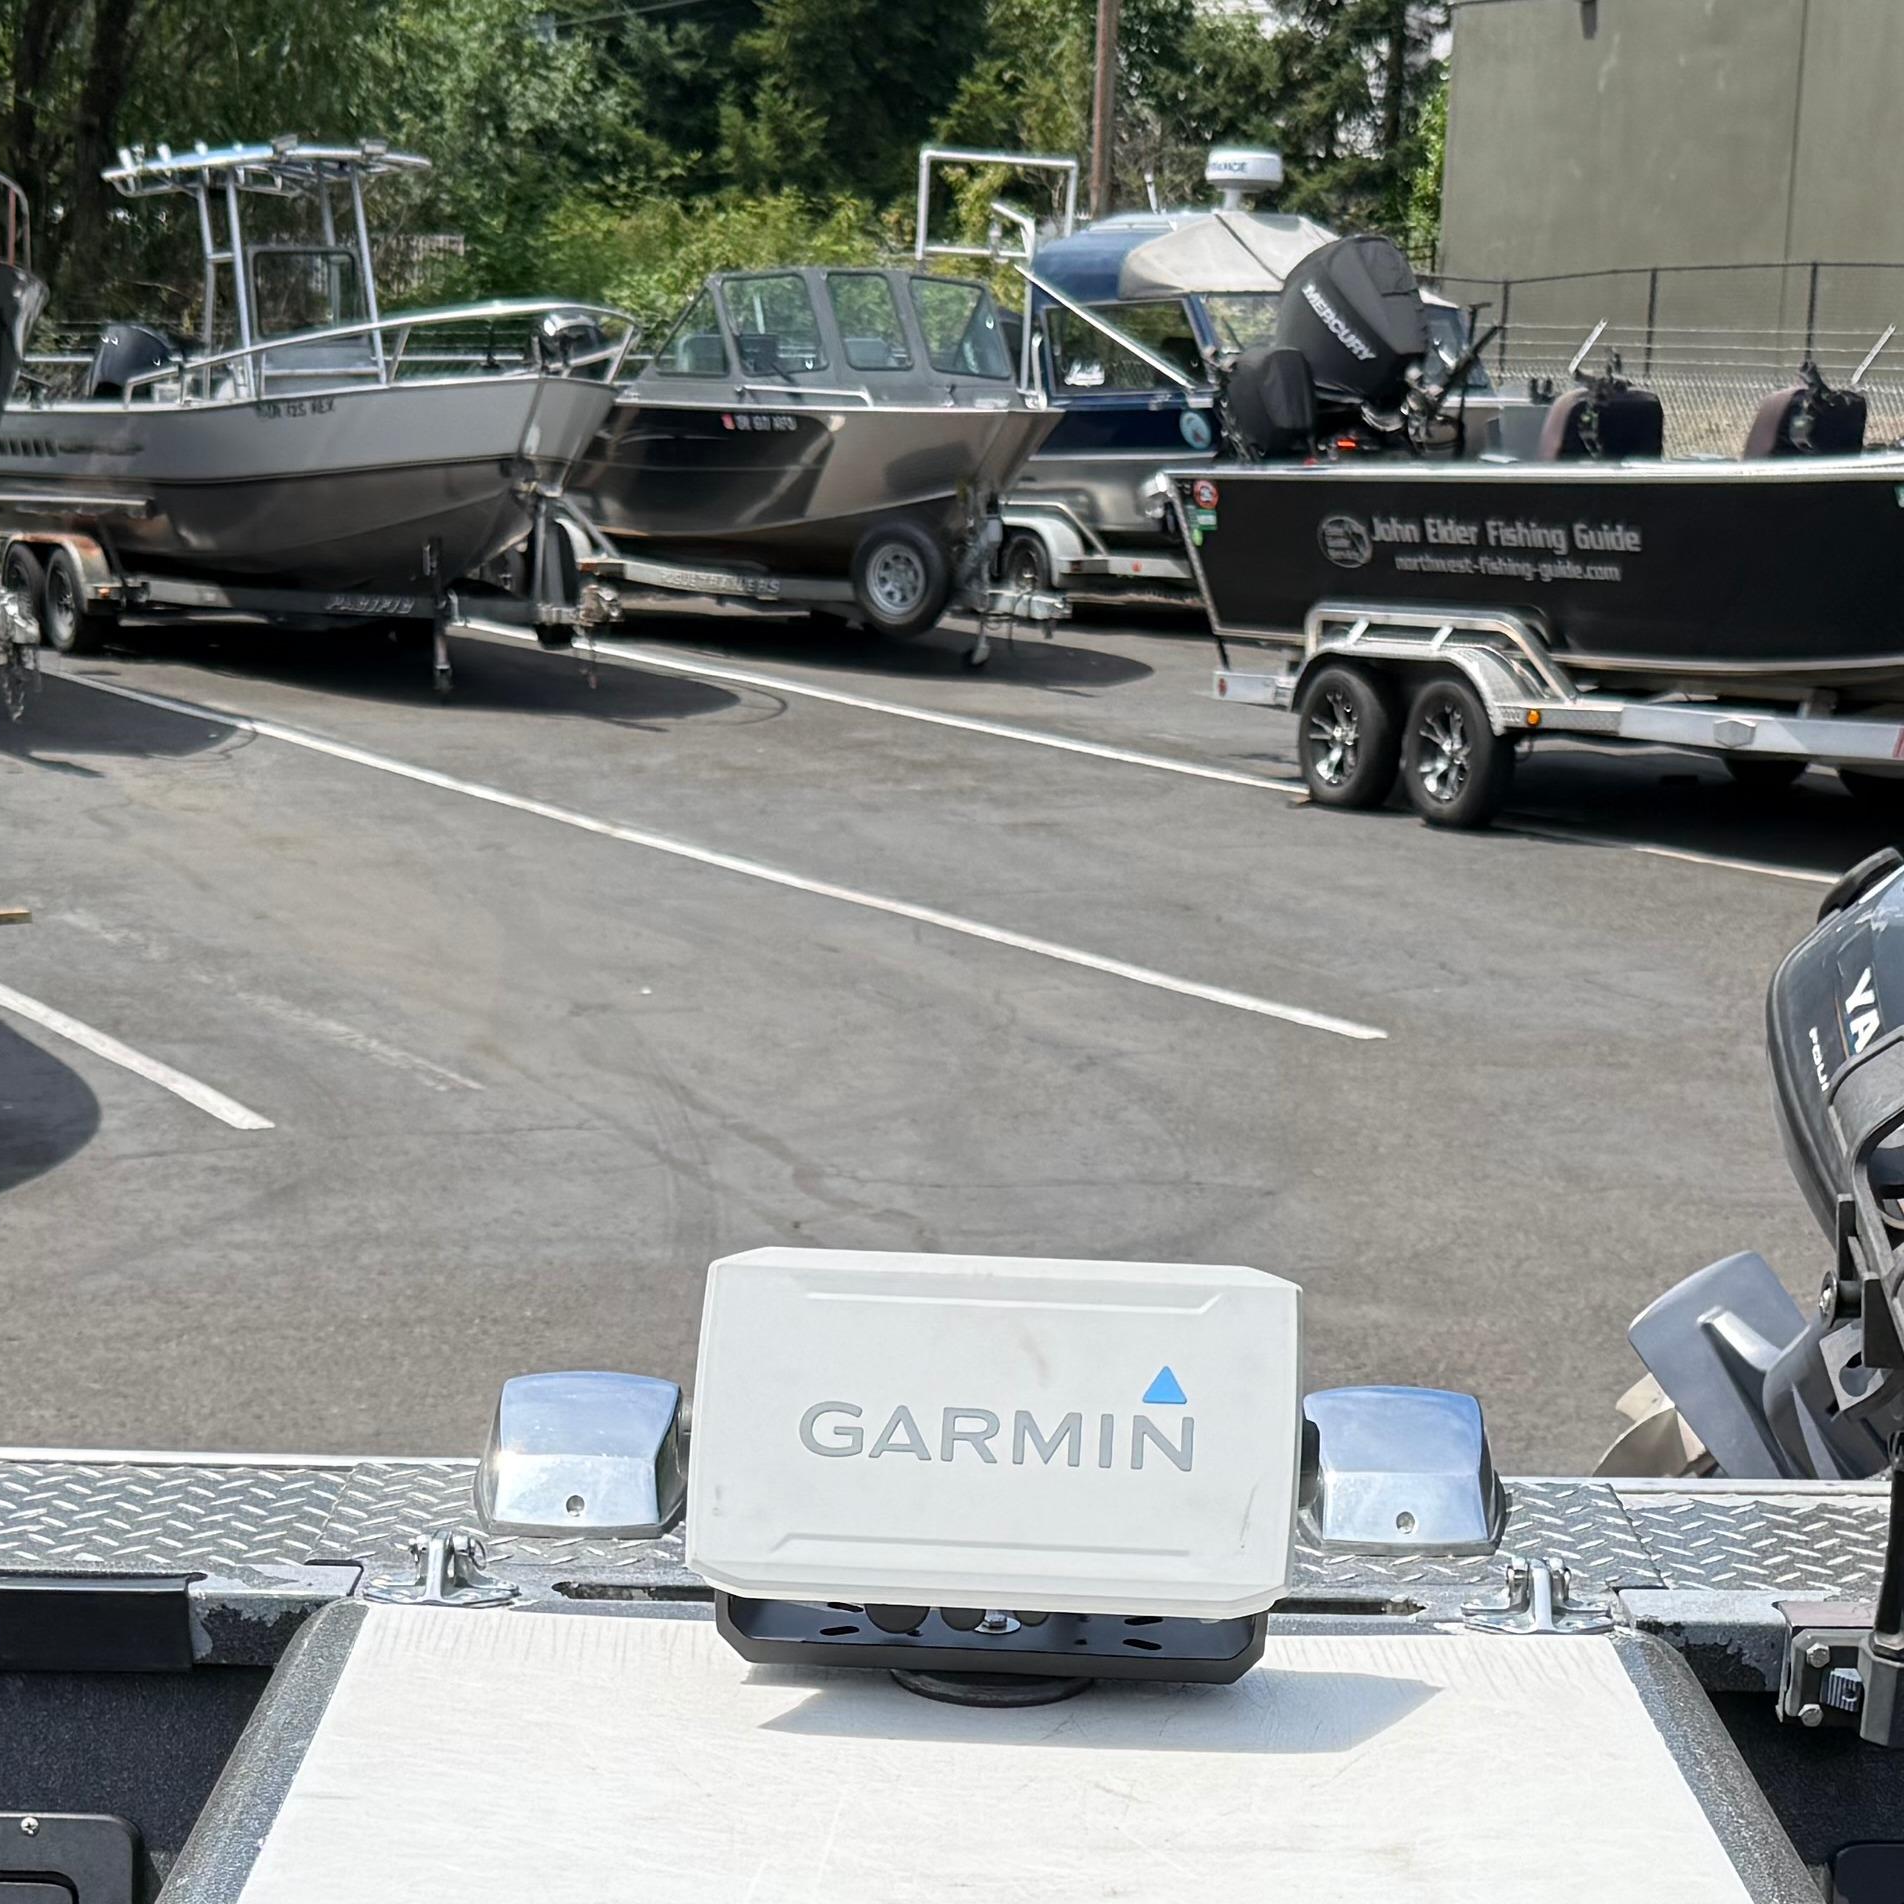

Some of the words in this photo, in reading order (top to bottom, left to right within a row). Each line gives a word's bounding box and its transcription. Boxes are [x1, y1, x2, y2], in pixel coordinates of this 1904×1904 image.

[1302, 284, 1377, 361] MERCURY
[1370, 517, 1421, 543] John
[1424, 518, 1478, 546] Elder
[1485, 520, 1568, 555] Fishing
[1572, 523, 1642, 552] Guide
[1394, 553, 1622, 582] northwest-fishing-guide.com
[1808, 1026, 1830, 1092] FOU
[798, 1400, 1196, 1473] GARMIN
